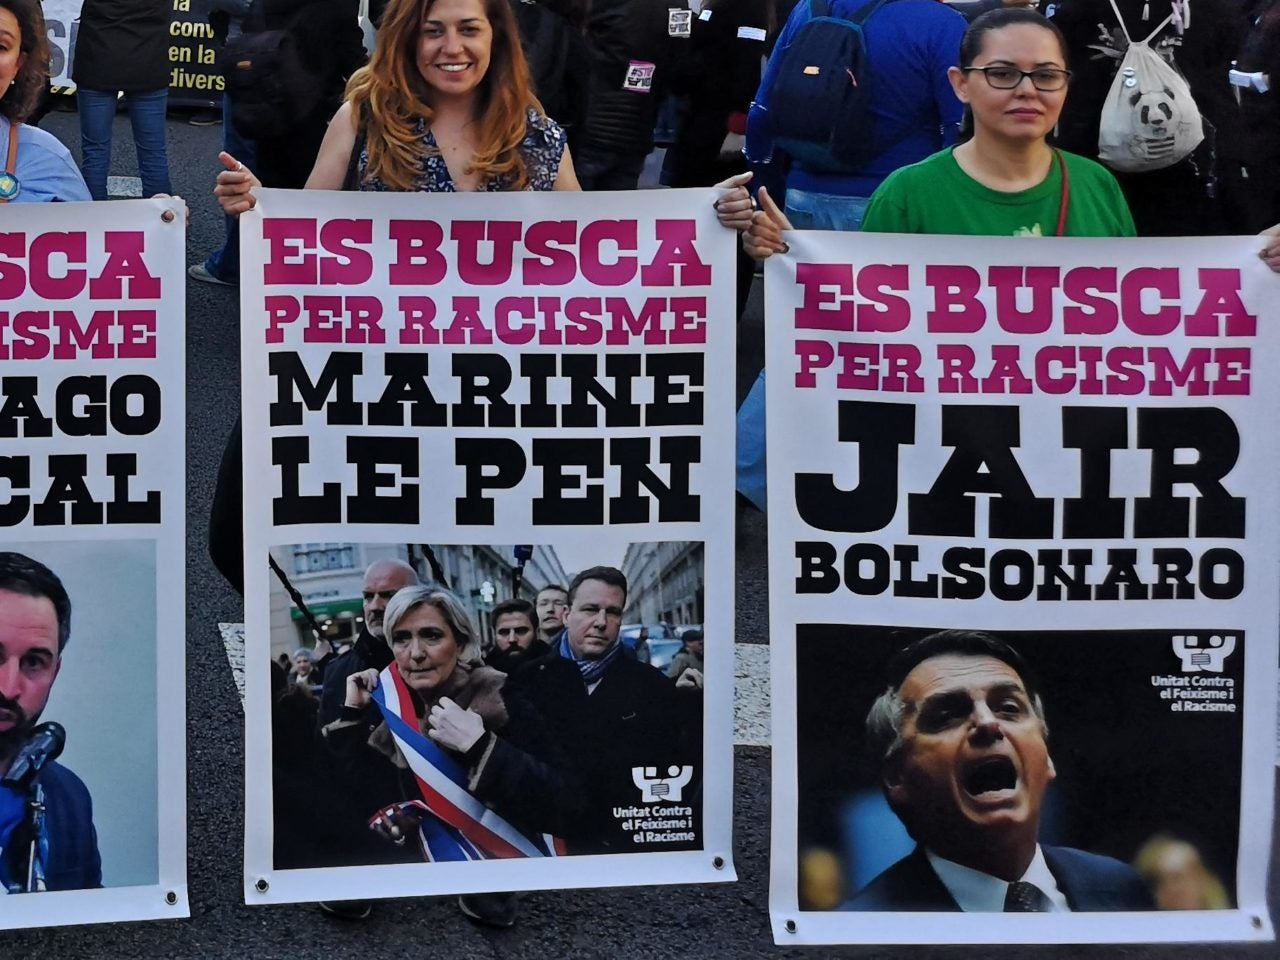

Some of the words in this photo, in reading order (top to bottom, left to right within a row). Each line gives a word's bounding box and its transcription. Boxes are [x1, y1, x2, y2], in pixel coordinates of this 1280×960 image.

[168, 46, 192, 62] en
[197, 44, 216, 64] la
[263, 218, 374, 286] ES
[389, 218, 712, 288] BUSCA
[265, 294, 386, 344] PER
[399, 295, 707, 346] RACISME
[794, 261, 911, 334] ES
[925, 264, 1258, 337] BUSCA
[269, 351, 705, 428] MARINE
[794, 339, 926, 393] PER
[937, 343, 1251, 397] RACISME
[272, 435, 420, 526] LE
[455, 435, 702, 526] PEN
[794, 400, 1247, 540] JAIR
[794, 541, 1246, 602] BOLSONARO
[1151, 675, 1190, 686] Unitat
[1192, 676, 1234, 686] Contra
[1160, 688, 1171, 699] el
[1173, 688, 1227, 699] Feixisme
[1229, 688, 1234, 700] i
[1171, 701, 1182, 712] el
[1184, 700, 1236, 712] Racisme
[613, 806, 650, 818] Unitat
[652, 806, 692, 816] Contra
[622, 820, 633, 830] el
[635, 818, 686, 830] Feixisme
[688, 816, 692, 828] i
[634, 832, 644, 842] el
[646, 830, 695, 842] Racisme
